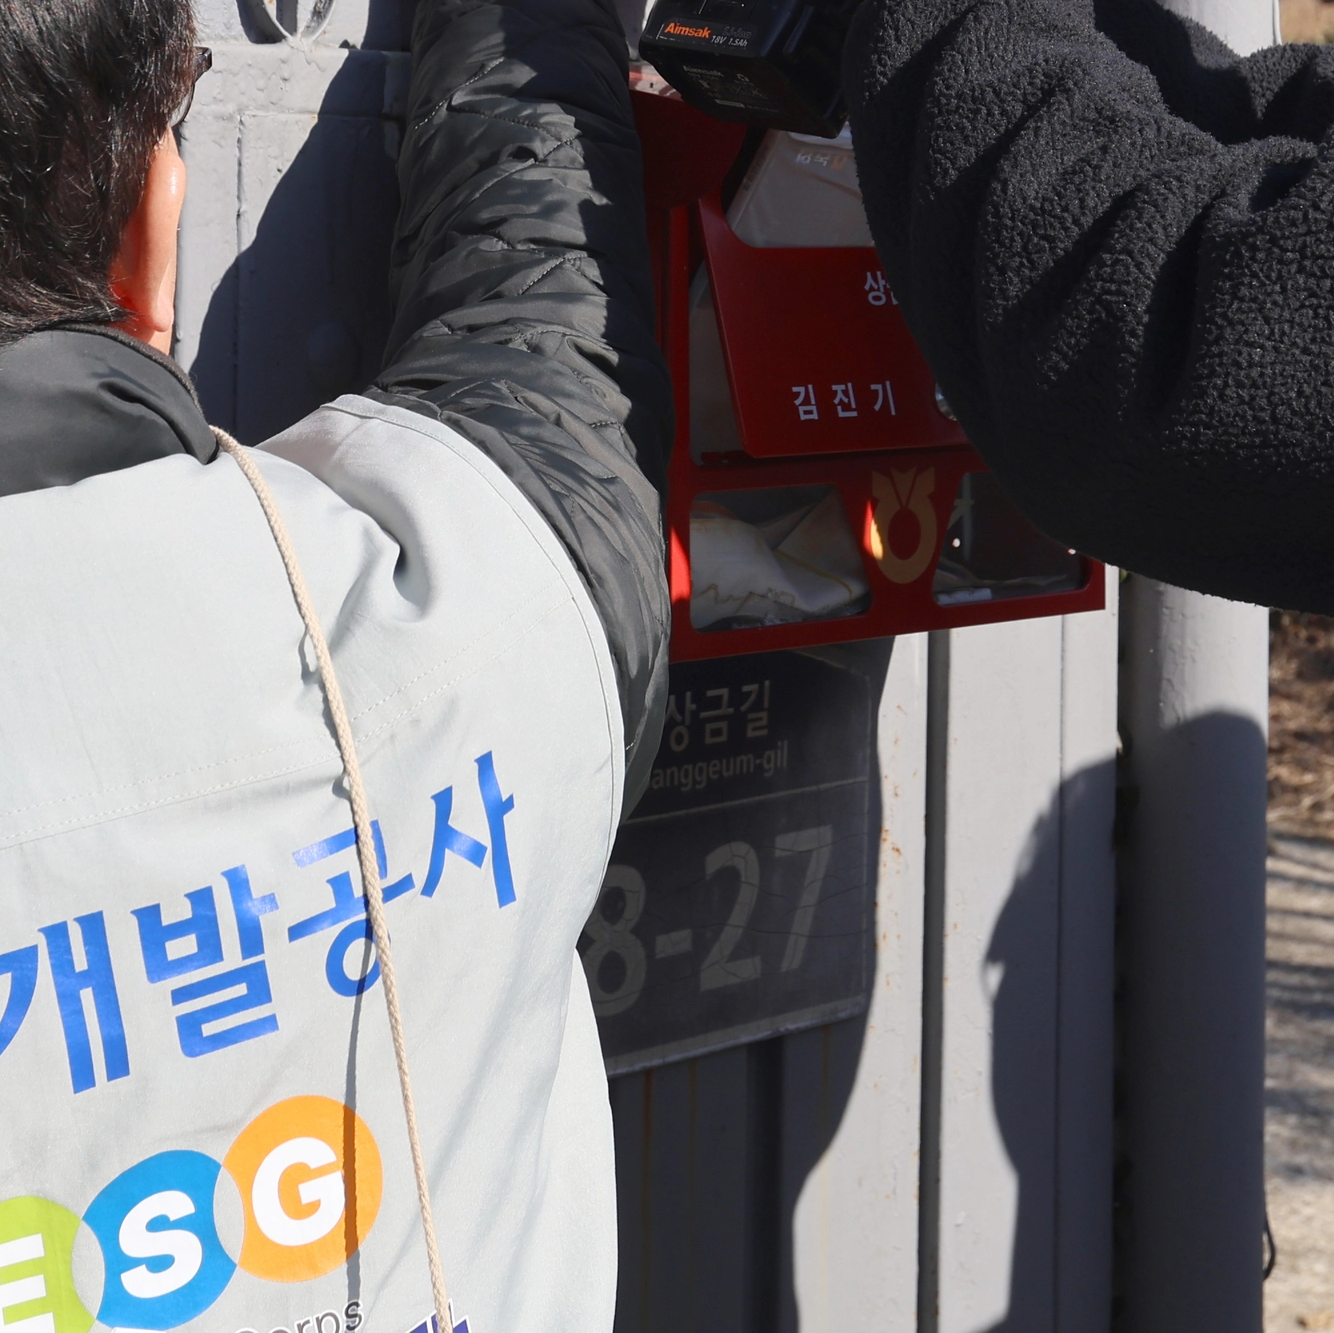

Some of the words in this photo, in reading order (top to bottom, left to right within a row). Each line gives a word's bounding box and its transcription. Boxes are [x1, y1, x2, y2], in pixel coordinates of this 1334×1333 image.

[664, 22, 712, 39] Aimsak
[710, 35, 728, 45] 18V
[863, 270, 899, 306] 상
[665, 679, 771, 753] 상금길
[646, 739, 789, 793] anggeum-gil
